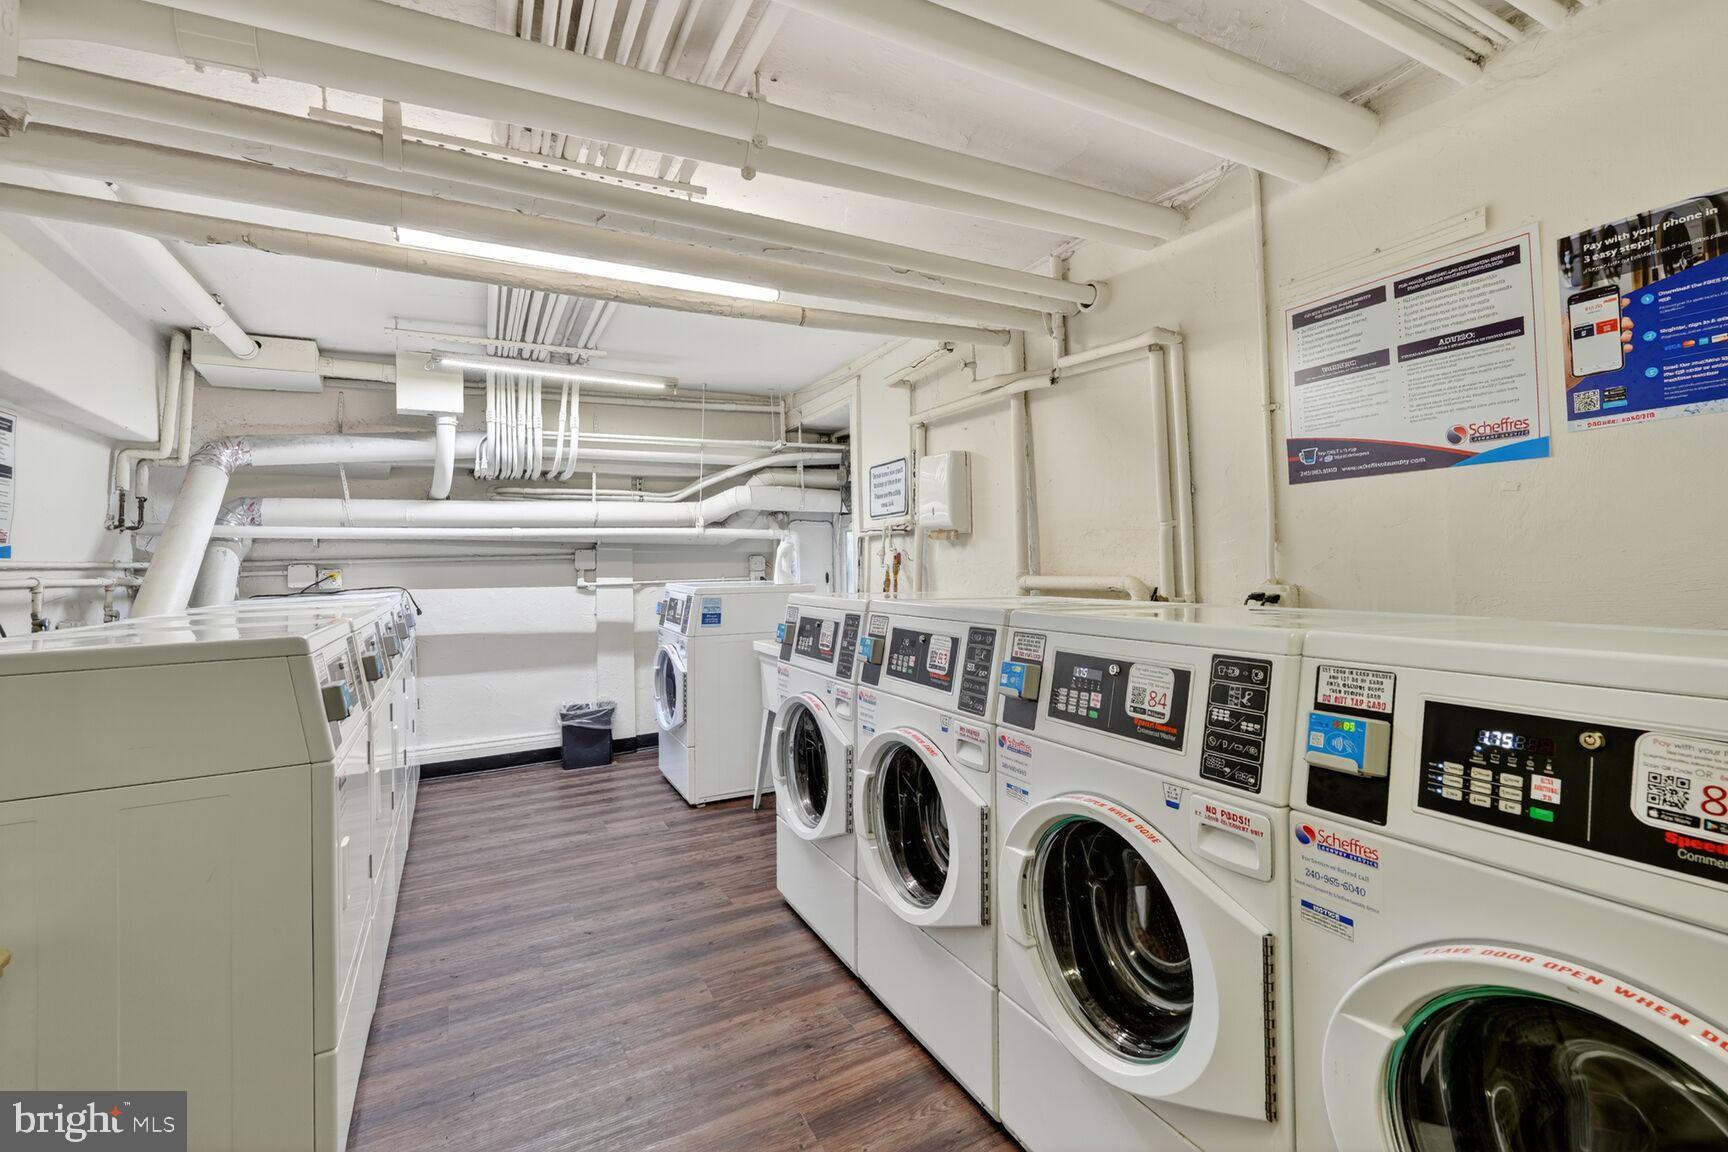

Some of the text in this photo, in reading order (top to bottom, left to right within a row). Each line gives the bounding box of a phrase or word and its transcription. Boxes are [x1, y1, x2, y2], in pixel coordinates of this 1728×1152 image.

[1583, 206, 1719, 253] Pay with your phone in
[1592, 249, 1618, 264] easy
[1619, 237, 1655, 254] steps!
[1469, 417, 1530, 437] Scheffres
[1147, 690, 1168, 710] 84
[1695, 768, 1713, 780] OR
[1205, 804, 1217, 815] NO
[1317, 828, 1379, 861] Scheffres
[1480, 948, 1536, 964] DOOR
[1541, 961, 1605, 986] OPEN
[1614, 984, 1690, 1027] WHEN
